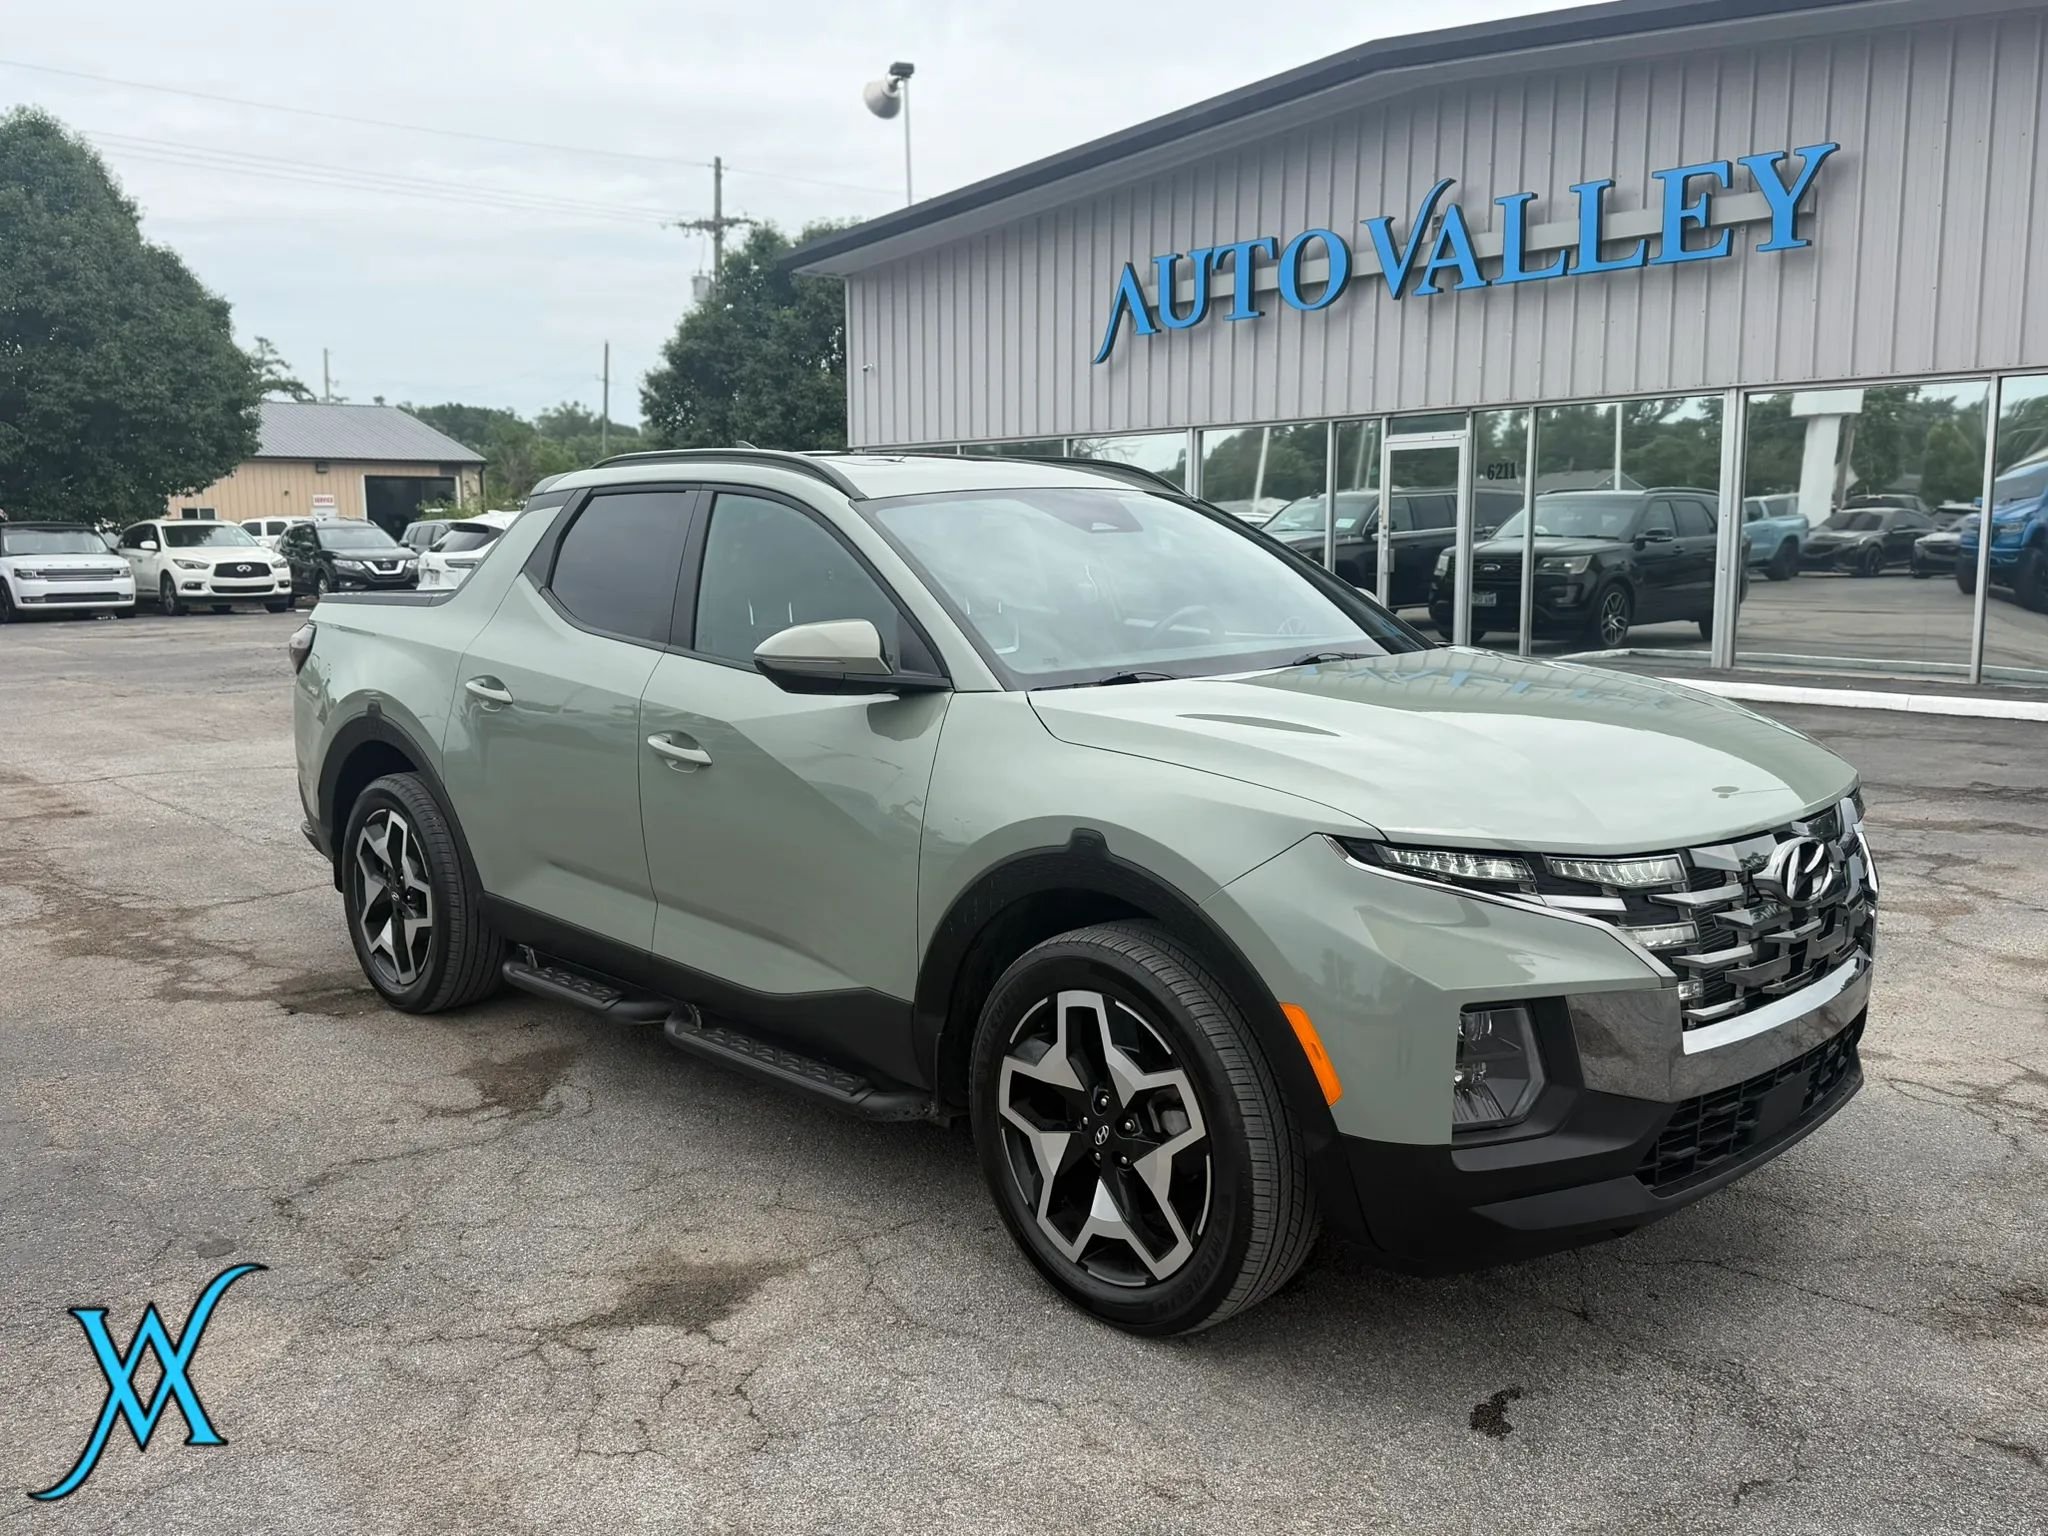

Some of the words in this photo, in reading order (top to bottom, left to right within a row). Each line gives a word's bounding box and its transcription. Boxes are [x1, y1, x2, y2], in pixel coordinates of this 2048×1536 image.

[1091, 229, 1352, 364] AUTO
[1361, 142, 1840, 300] VALLEY
[1487, 462, 1516, 480] 6211
